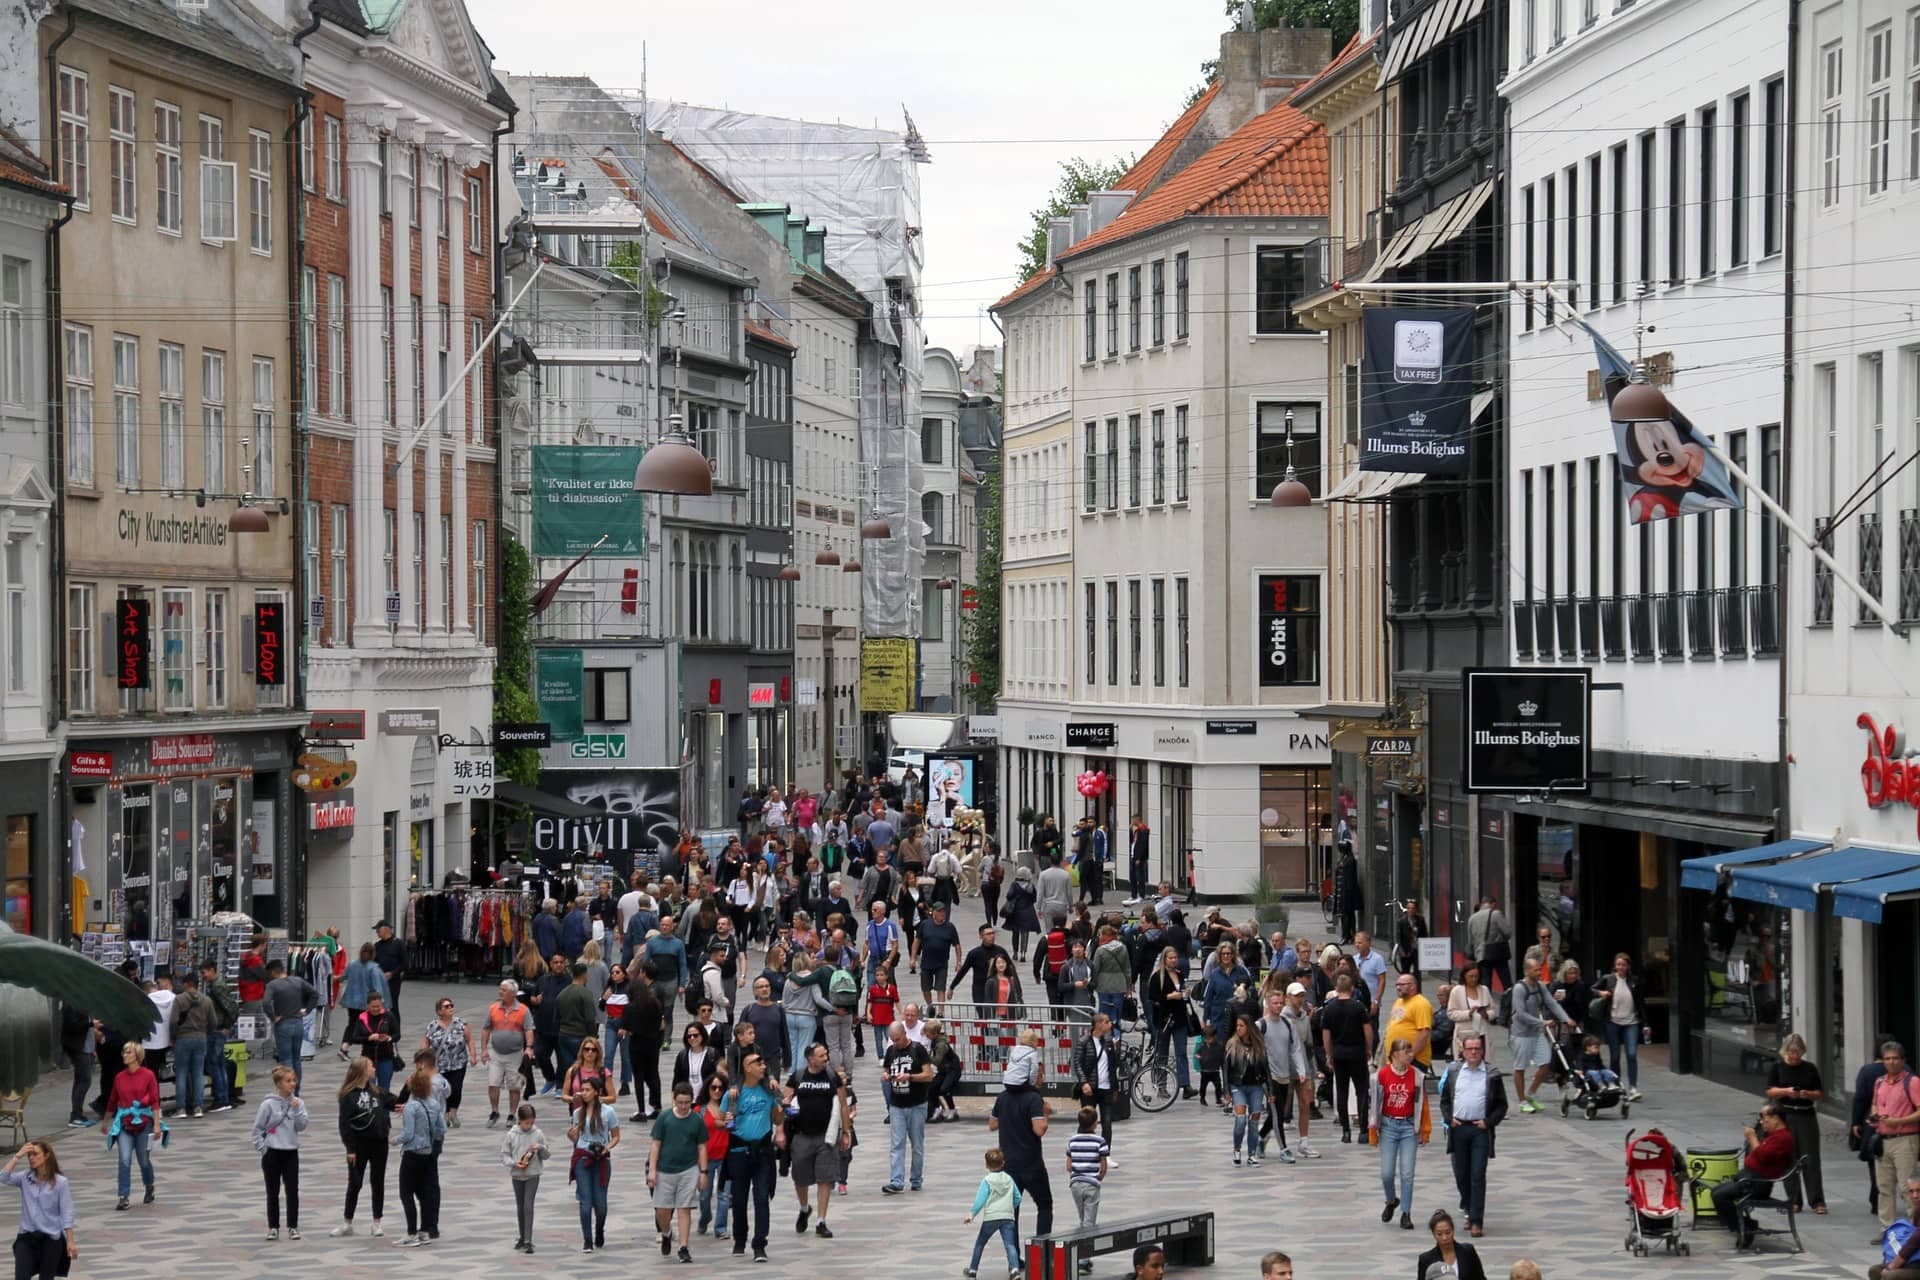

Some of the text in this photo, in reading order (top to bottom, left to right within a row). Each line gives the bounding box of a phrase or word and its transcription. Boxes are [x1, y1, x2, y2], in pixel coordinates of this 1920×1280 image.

[1400, 369, 1437, 379] TAX FREE
[1367, 438, 1465, 458] Illums Bolighus
[594, 480, 605, 489] er
[609, 479, 633, 489] ikke
[548, 492, 559, 503] til
[118, 508, 228, 548] City KunstnerArtikler
[120, 602, 139, 687] Art Shop
[1271, 618, 1286, 666] Orbit
[260, 631, 278, 684] Floor
[499, 730, 546, 740] Souvenirs
[1068, 728, 1110, 737] CHANGE
[1474, 730, 1580, 748] Illums Bolighus
[152, 736, 213, 760] Danish Souvenirs
[571, 742, 625, 758] GSV
[1289, 734, 1329, 750] PAN
[1370, 740, 1412, 752] SCARPA
[76, 756, 106, 766] Gifts &
[454, 760, 492, 778] 琥珀
[71, 765, 111, 775] Souvenirs
[174, 787, 188, 803] Gifts
[214, 785, 233, 800] Change
[453, 784, 492, 796] コハク
[122, 792, 150, 808] Souvenirs
[174, 865, 188, 882] Gifts
[214, 862, 233, 878] Change
[122, 872, 150, 888] Souvenirs
